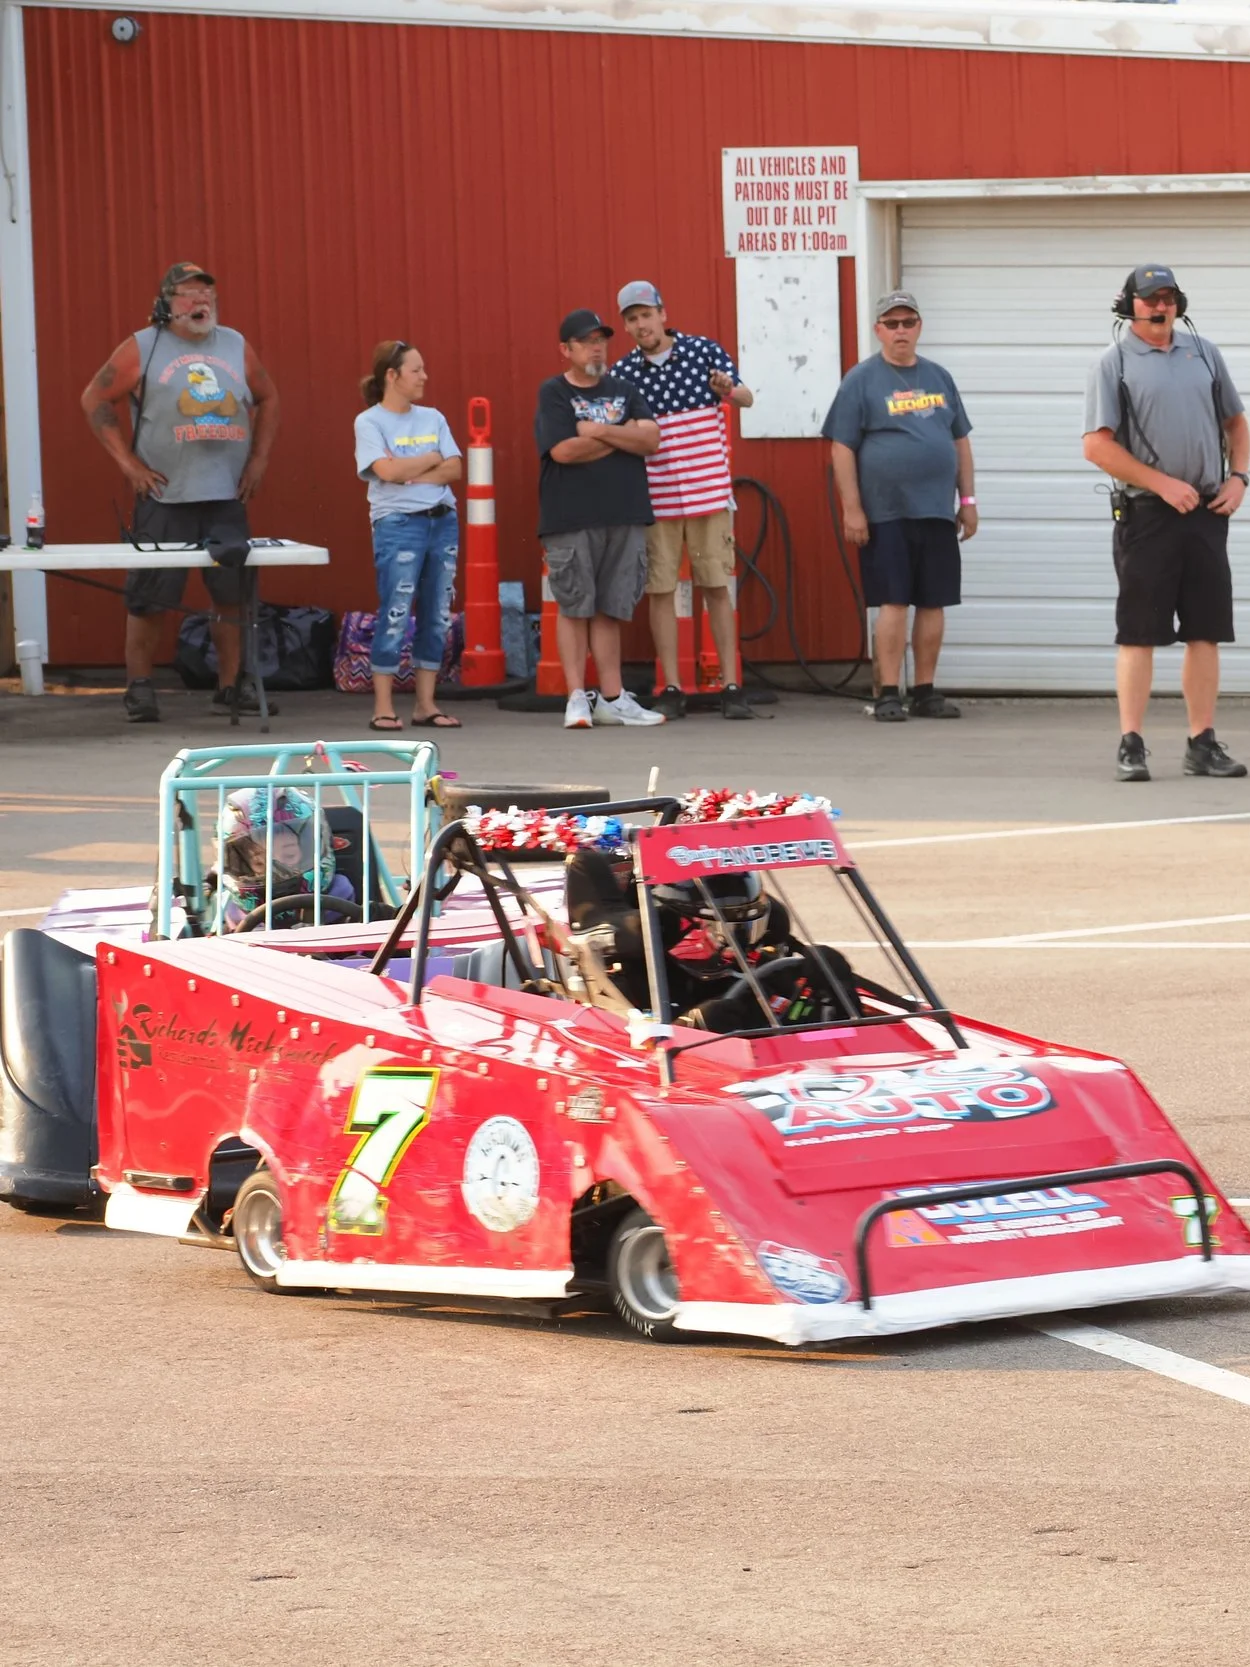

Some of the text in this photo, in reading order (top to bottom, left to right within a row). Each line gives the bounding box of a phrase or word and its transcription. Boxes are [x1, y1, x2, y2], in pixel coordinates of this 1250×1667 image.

[736, 155, 846, 176] ALL VEHICLES AND
[735, 181, 848, 201] PATRONS MUST BE
[747, 206, 836, 226] OUT OF ALL PIT
[738, 231, 847, 251] AREAS BY 1:00am
[782, 1080, 1052, 1135] AUTO
[329, 1066, 441, 1236] 7
